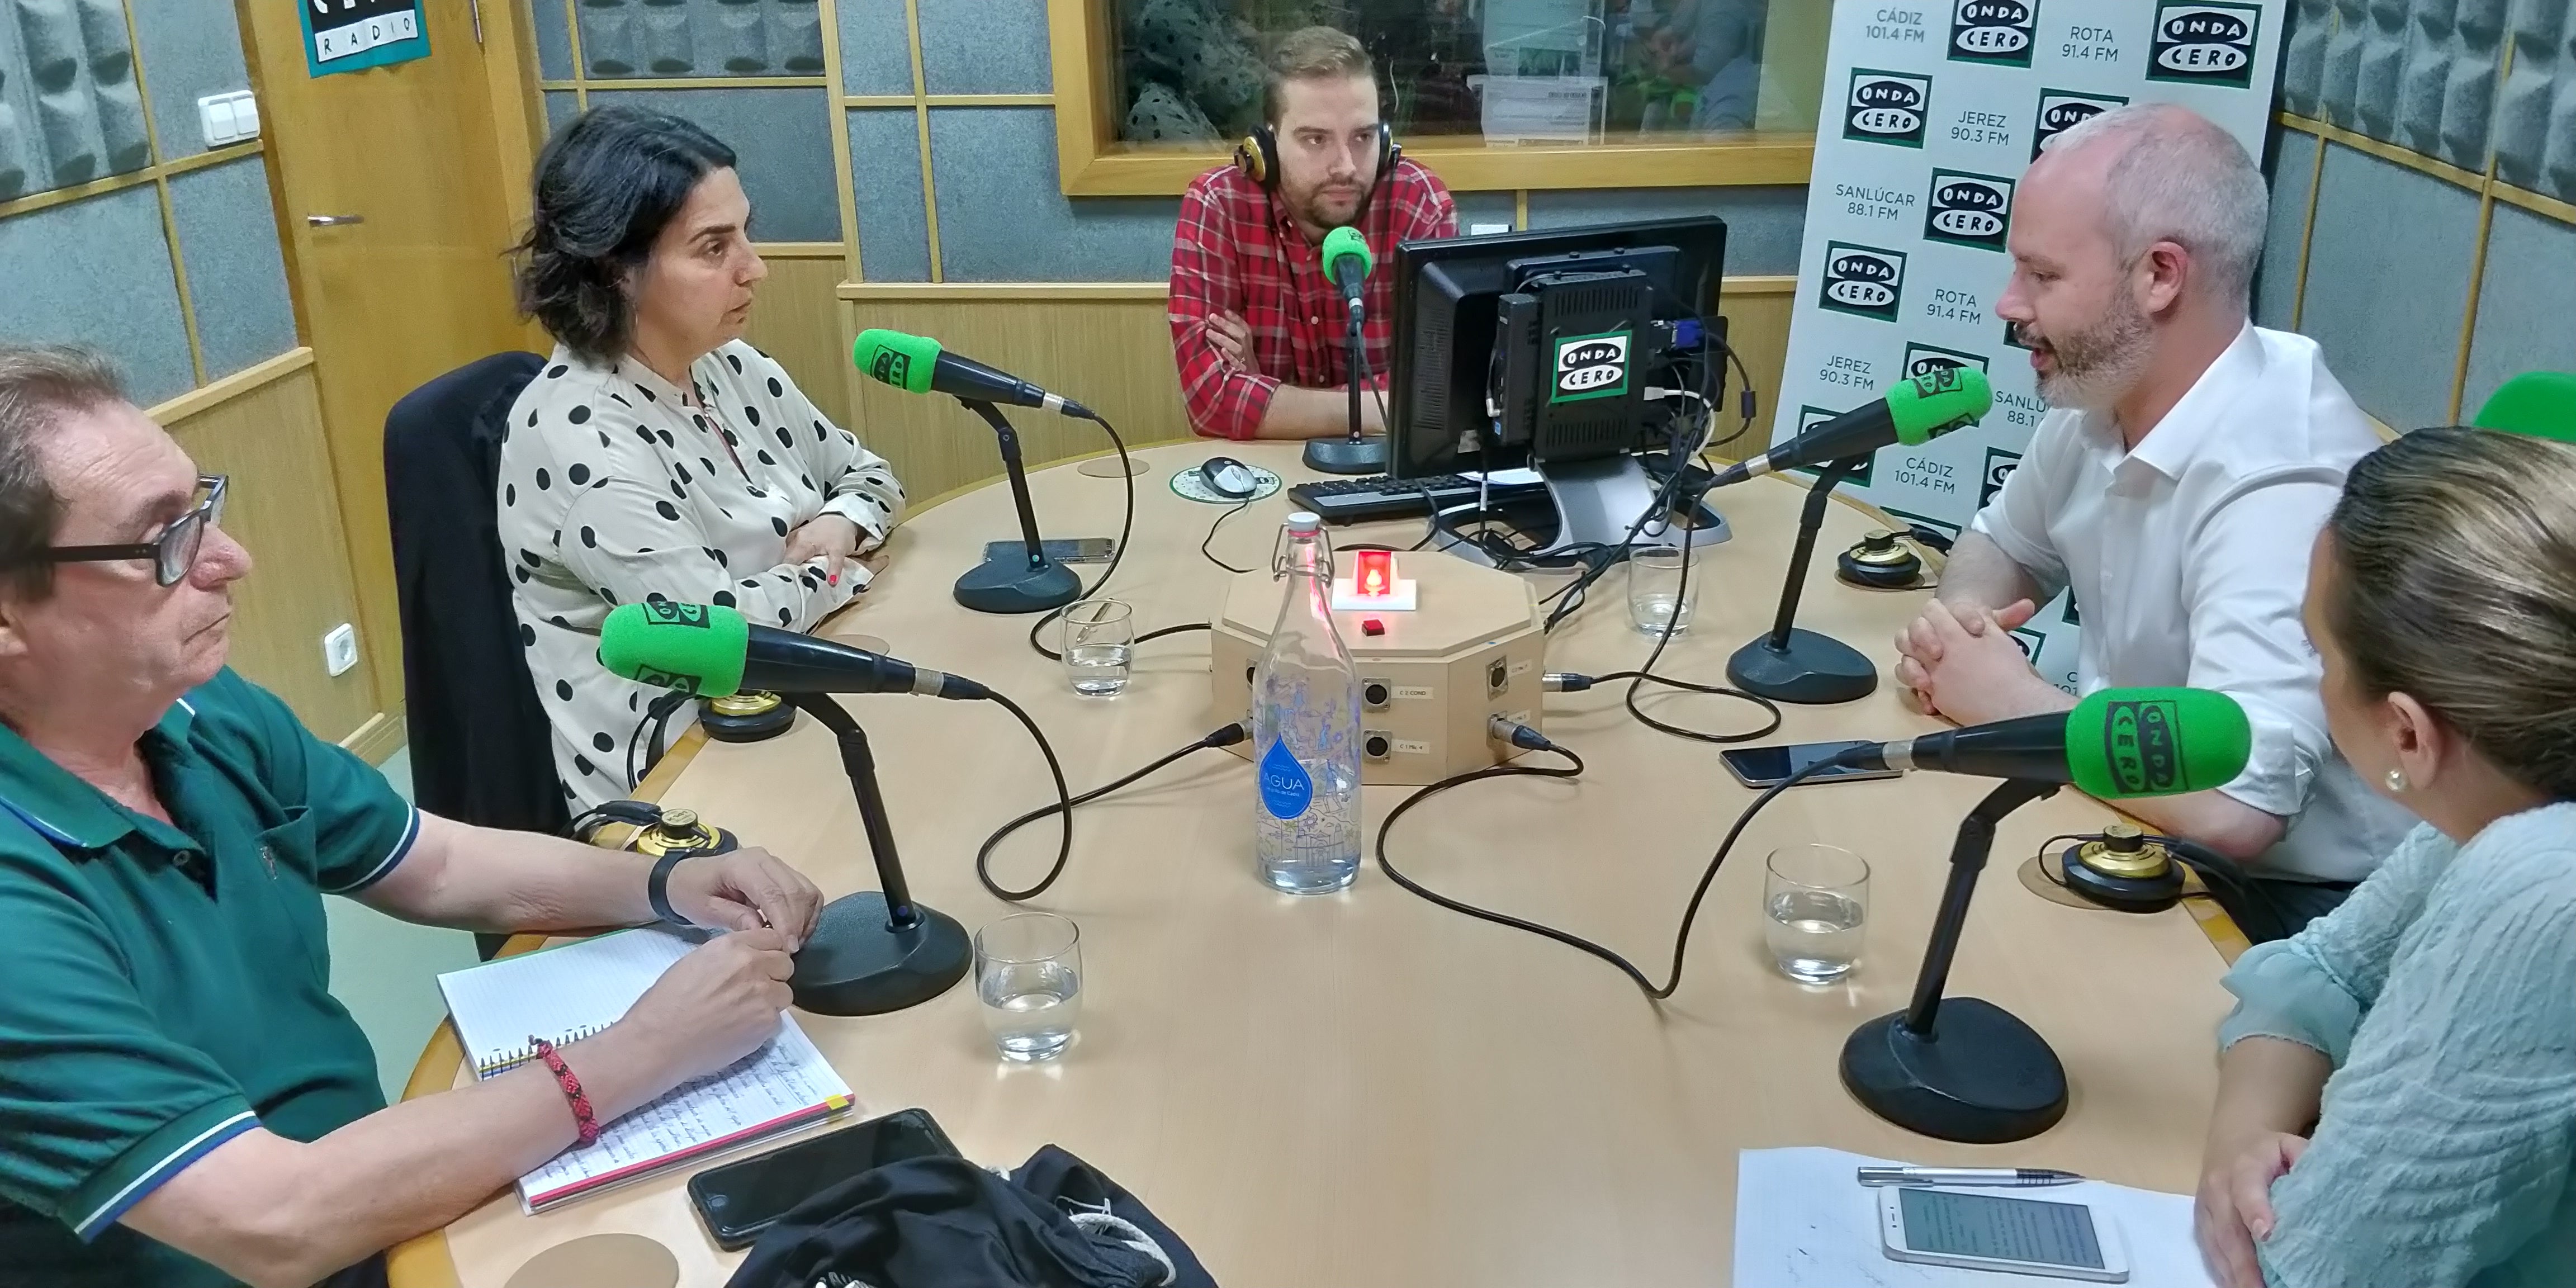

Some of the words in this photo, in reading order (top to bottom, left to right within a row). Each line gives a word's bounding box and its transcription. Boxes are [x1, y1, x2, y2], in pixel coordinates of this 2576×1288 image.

[1877, 7, 1923, 25] CÁDIZ
[1967, 4, 2023, 20] ONDA
[324, 17, 410, 55] RADIO
[1865, 25, 1900, 41] 101.4
[1904, 29, 1924, 43] FM
[2070, 26, 2114, 44] ROTA
[2171, 20, 2241, 37] ONDA
[1967, 31, 2019, 48] CERO
[2062, 44, 2090, 59] 91.4
[2095, 47, 2119, 63] FM
[2171, 49, 2237, 67] CERO
[1862, 87, 1915, 103] ONDA
[1862, 112, 1911, 129] CERO
[1958, 111, 2007, 129] JEREZ
[2051, 110, 2092, 122] OND
[1951, 126, 1983, 144] 90.3
[1987, 132, 2010, 146] FM
[1835, 184, 1916, 207] SANLÚCAR
[1943, 188, 1998, 207] ONDA
[1848, 202, 1873, 217] 88.1
[1877, 207, 1898, 221] FM
[1943, 213, 1995, 232] CERO
[1838, 259, 1890, 278] ONDA
[1838, 283, 1886, 302] CERO
[1935, 288, 1977, 308] ROTA
[1927, 303, 1955, 320] 91.4
[1959, 309, 1981, 325] FM
[1568, 348, 1616, 364] ONDA
[1826, 355, 1872, 375] JEREZ
[1569, 370, 1614, 386] CERO
[1819, 369, 1849, 386] 90.3
[1853, 376, 1874, 391] FM
[2007, 410, 2035, 427] 88.1
[1906, 457, 1953, 479] CÁDIZ
[1895, 470, 1929, 489] 101.4
[1934, 480, 1955, 495] FM
[2117, 716, 2140, 784] CERO
[2147, 712, 2168, 783] ONDA
[1264, 773, 1304, 790] AGUA
